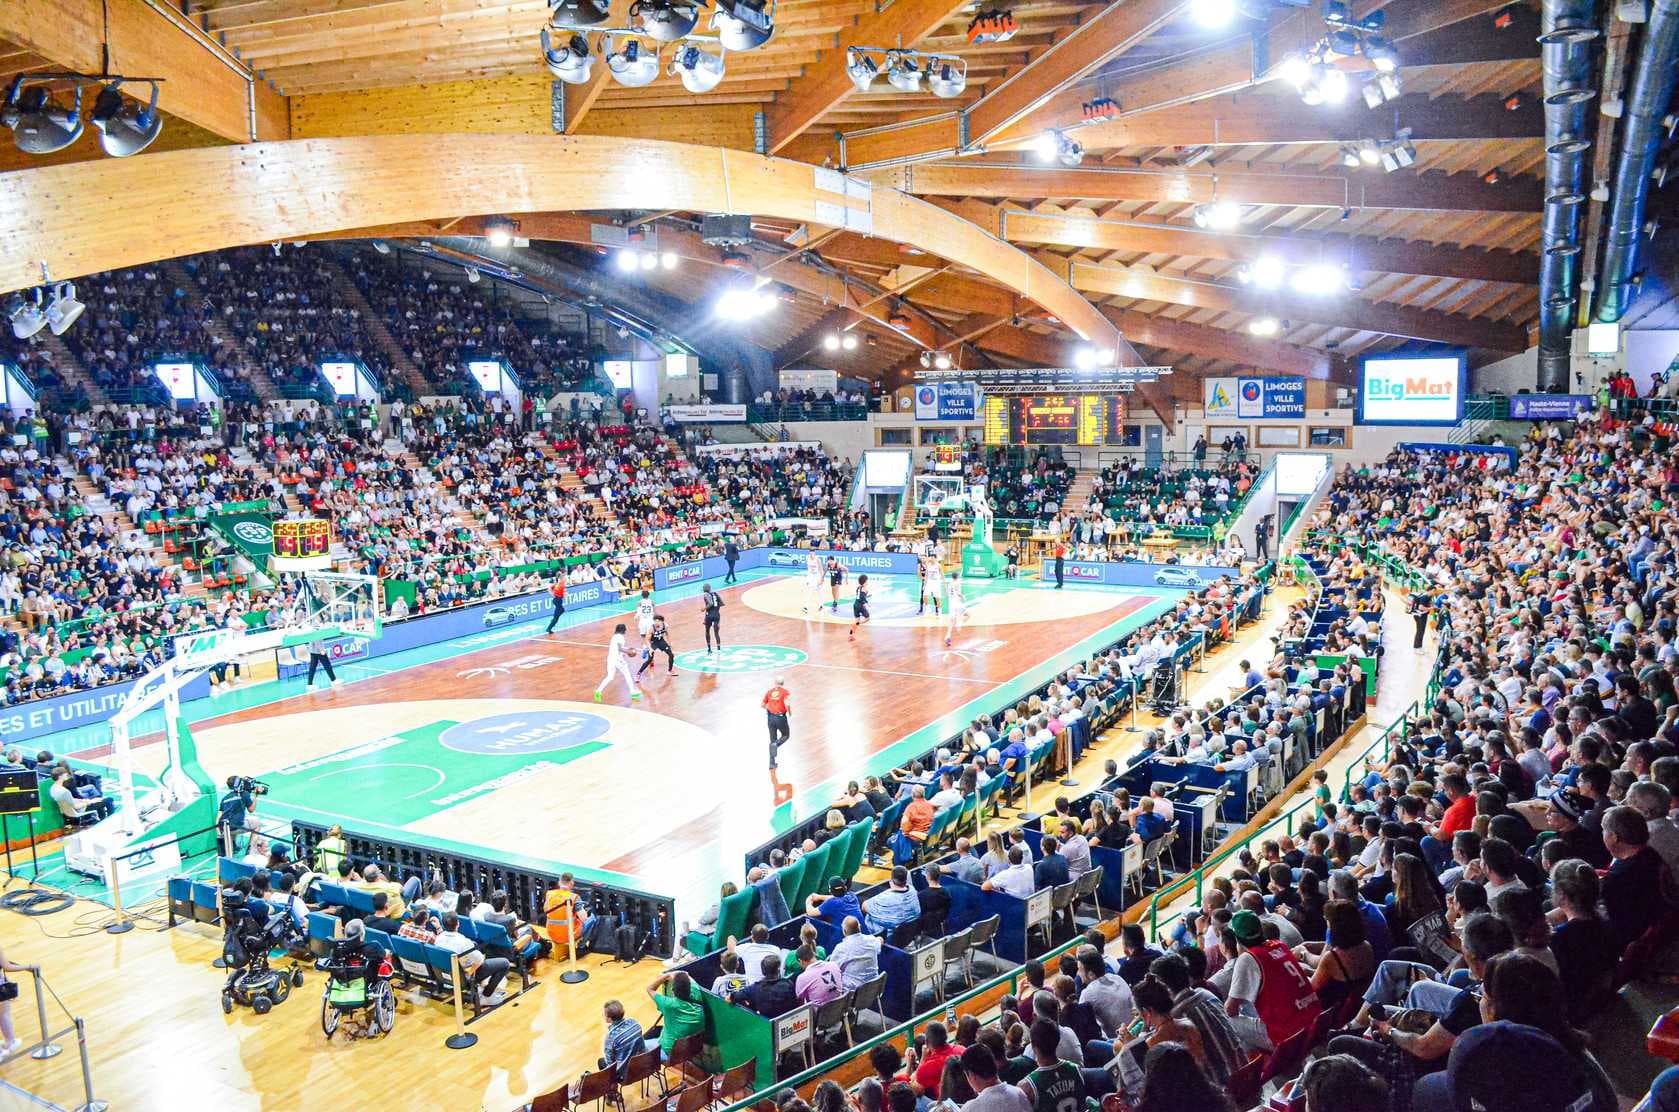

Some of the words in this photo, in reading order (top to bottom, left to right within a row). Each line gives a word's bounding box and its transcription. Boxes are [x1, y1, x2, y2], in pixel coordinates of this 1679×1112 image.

[939, 387, 972, 396] LIMOGES
[1266, 382, 1303, 391] LIMOGES
[1369, 377, 1453, 400] BigMat
[947, 399, 965, 407] VILLE
[1273, 395, 1295, 403] VILLE
[940, 407, 973, 416] SPORTIVE
[1265, 404, 1304, 413] SPORTIVE
[668, 569, 683, 581] RENT
[688, 566, 700, 578] CAR
[1049, 566, 1071, 575] RNT
[1081, 567, 1099, 577] CAR
[530, 599, 543, 614] ET
[545, 587, 600, 610] UITAIRES
[642, 605, 652, 614] 23
[342, 642, 362, 655] CAR
[29, 708, 54, 729] ET
[1282, 960, 1306, 989] 9
[780, 1019, 808, 1039] BigMat
[1046, 1080, 1075, 1098] TATUM
